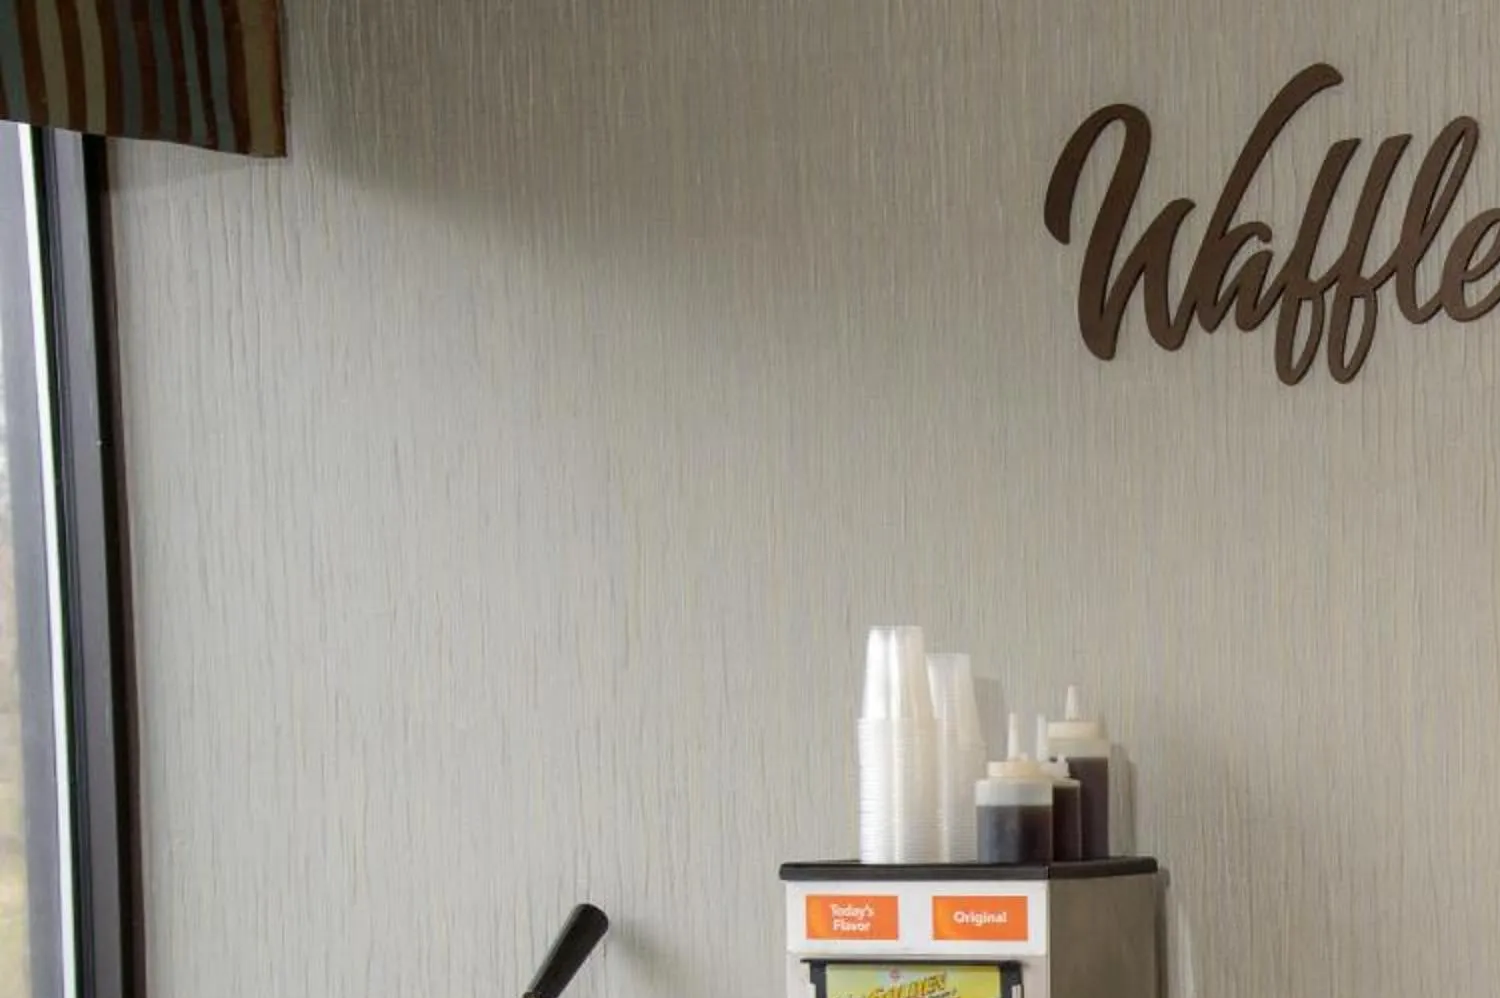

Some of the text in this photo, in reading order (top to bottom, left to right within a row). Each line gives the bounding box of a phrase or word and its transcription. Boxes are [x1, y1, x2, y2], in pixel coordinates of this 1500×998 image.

[830, 903, 875, 920] Today's
[953, 911, 1008, 927] Original
[832, 919, 872, 932] Flavor
